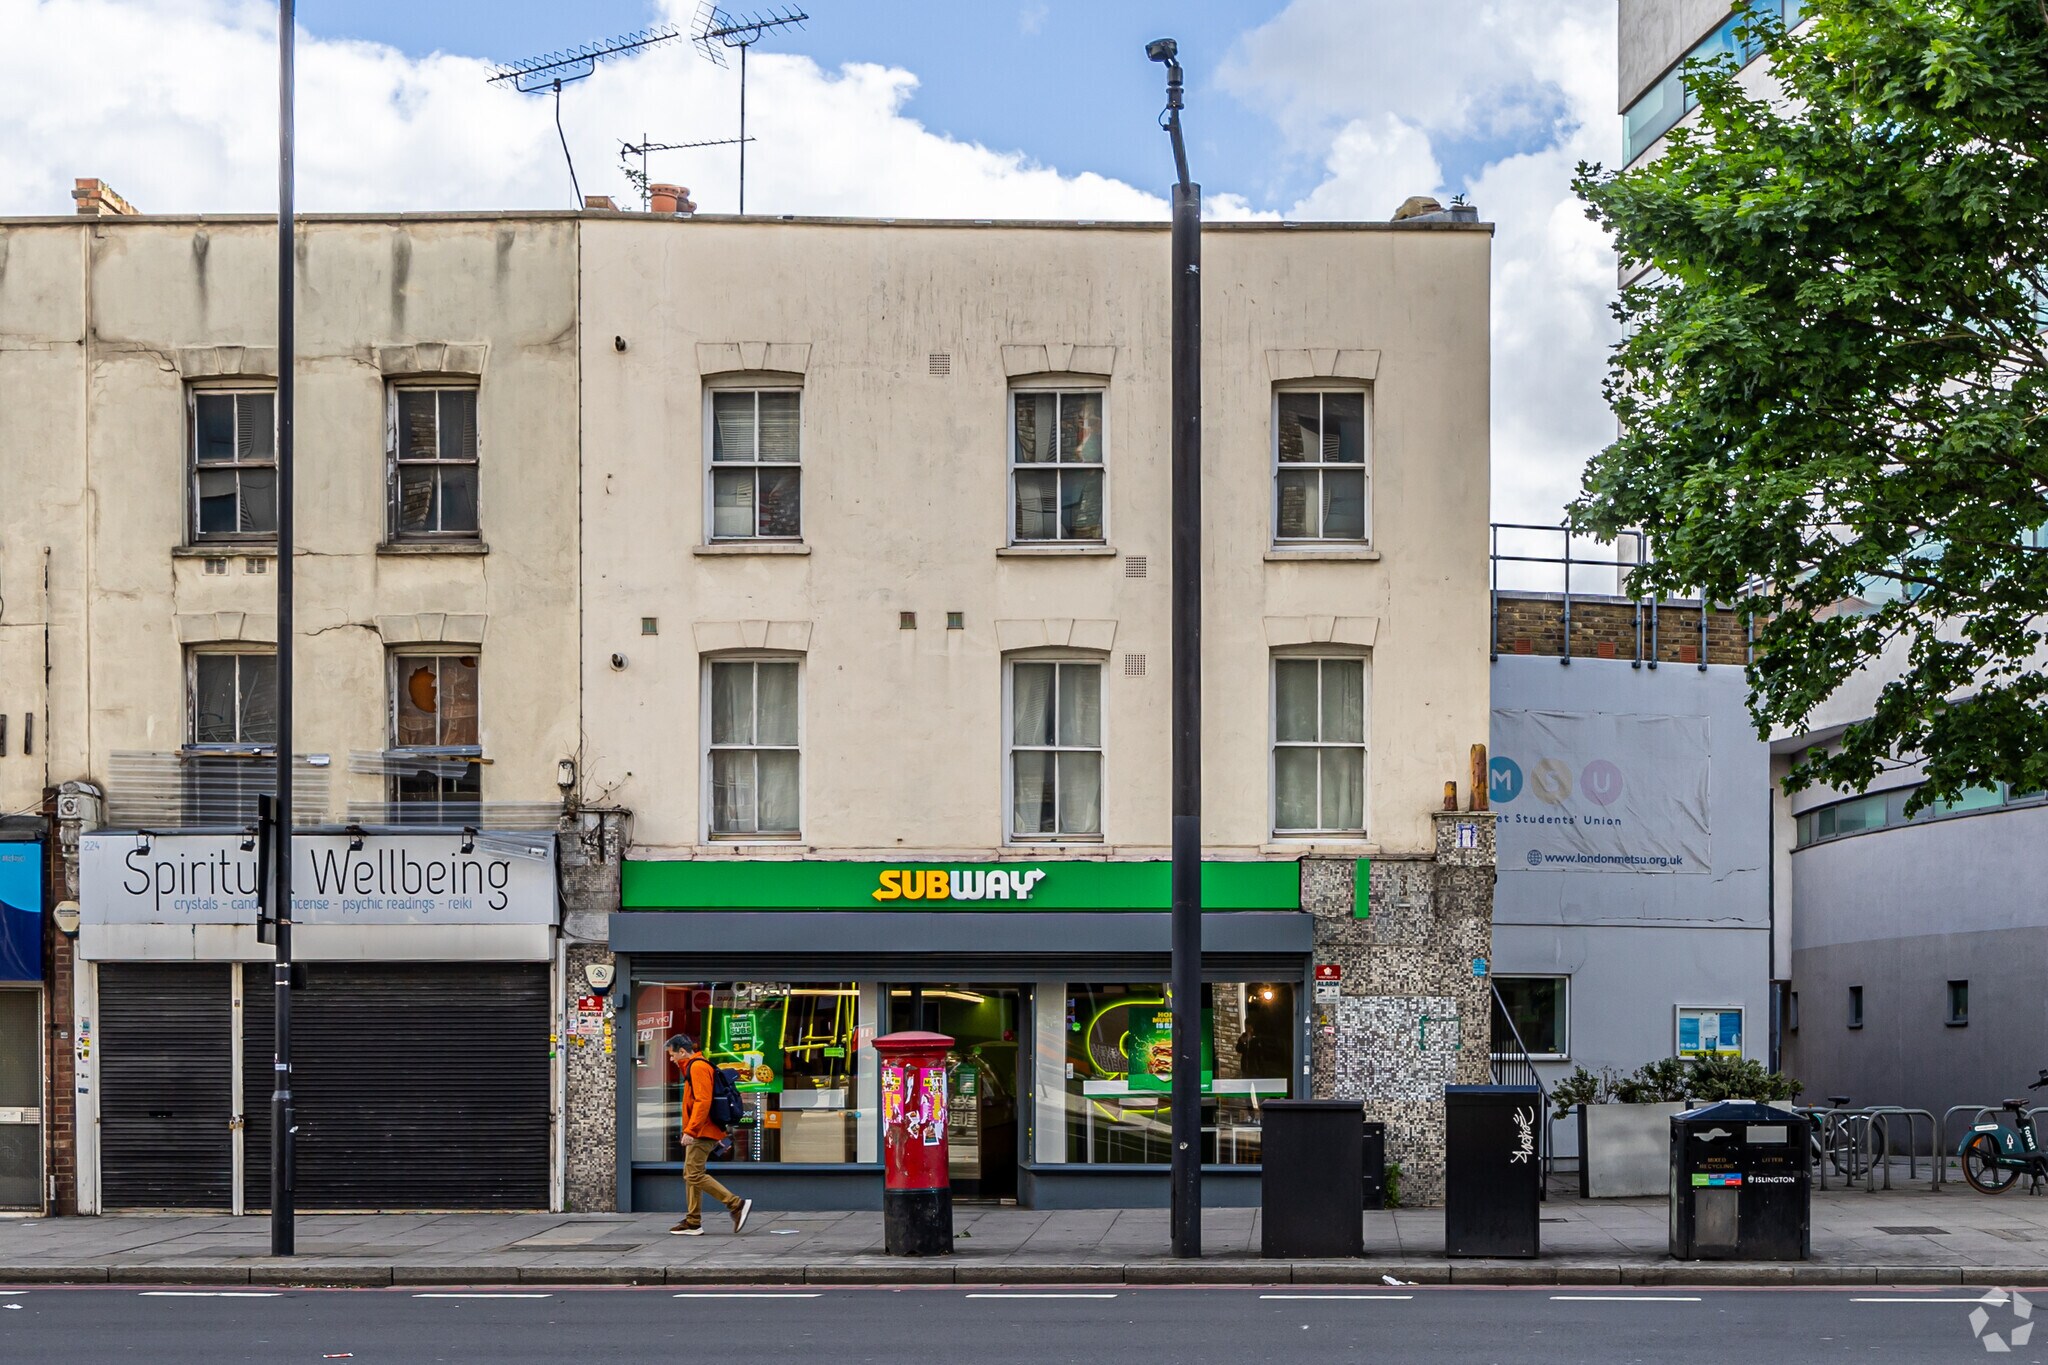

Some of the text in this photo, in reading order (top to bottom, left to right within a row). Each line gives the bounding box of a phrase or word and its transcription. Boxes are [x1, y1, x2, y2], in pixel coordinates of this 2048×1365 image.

[1496, 813, 1622, 826] et Students' Union
[84, 840, 100, 851] 224
[1544, 853, 1683, 867] www.londonmetsu.org.uk
[123, 848, 511, 912] Spiritu Wellbeing
[871, 867, 1047, 902] SUBWAY
[174, 896, 218, 914] crystals
[231, 897, 259, 910] cand
[291, 899, 329, 910] ncense
[342, 897, 383, 914] psychic
[386, 897, 435, 914] readings
[447, 897, 473, 910] reiki
[2023, 1125, 2036, 1151] forest
[1754, 1176, 1795, 1184] ISLINGTON
